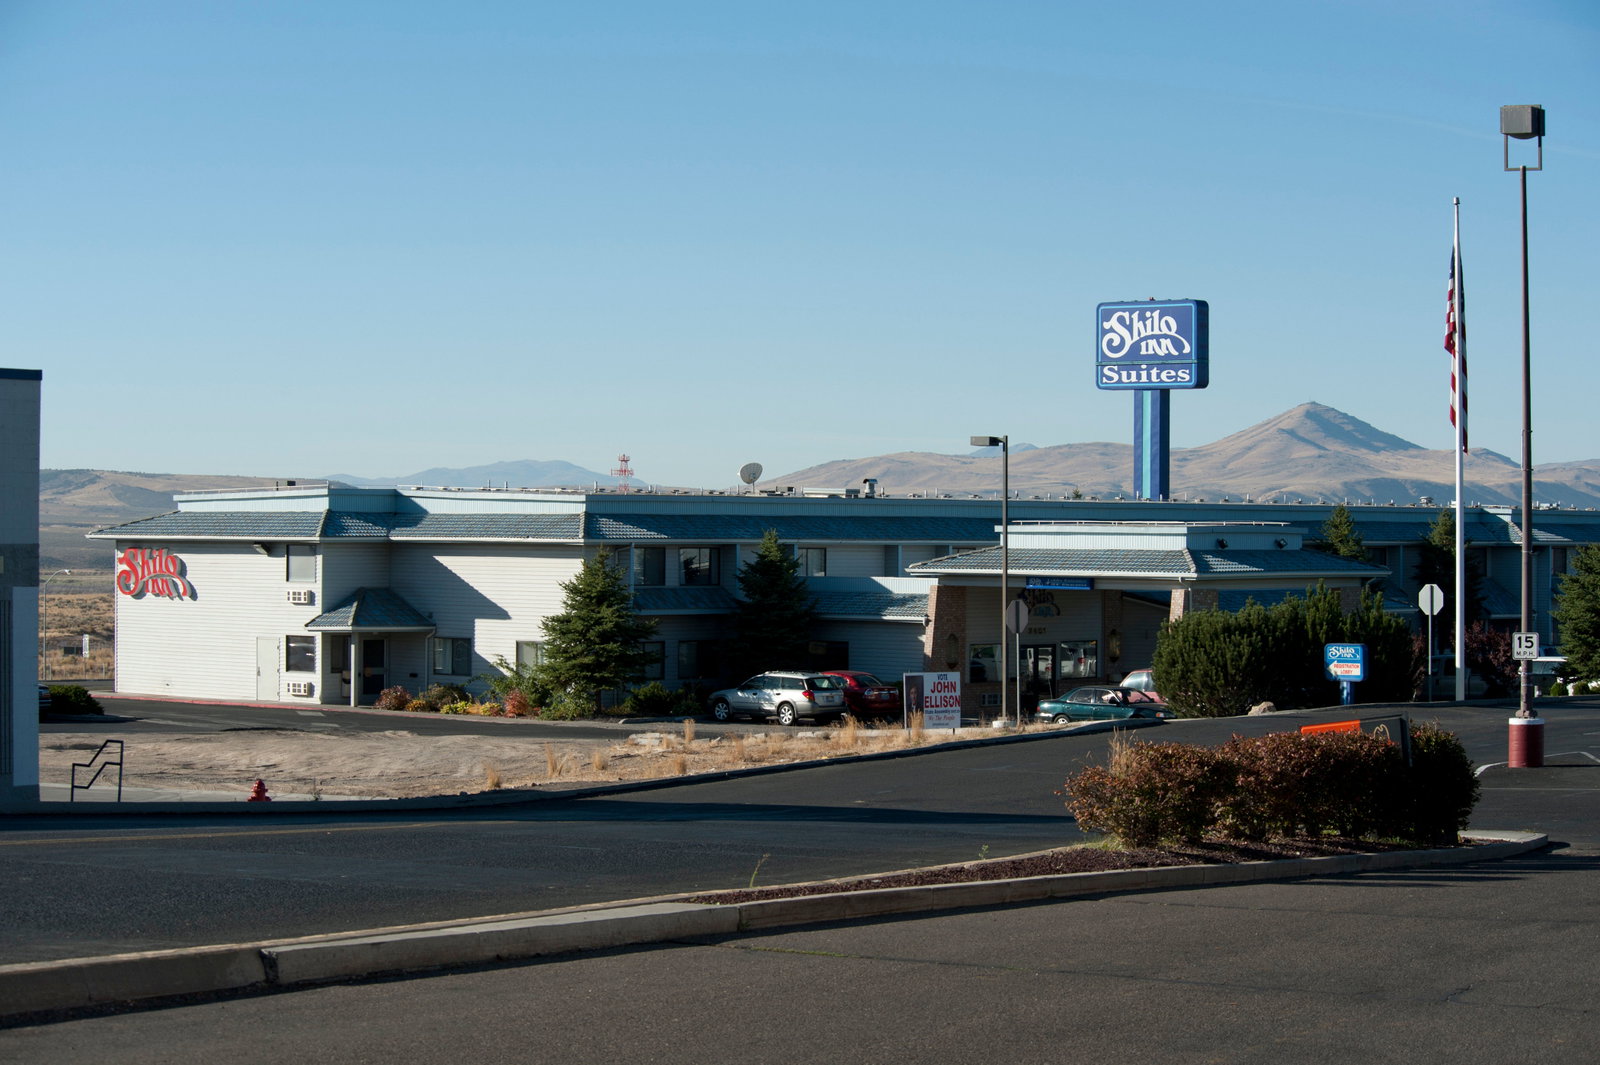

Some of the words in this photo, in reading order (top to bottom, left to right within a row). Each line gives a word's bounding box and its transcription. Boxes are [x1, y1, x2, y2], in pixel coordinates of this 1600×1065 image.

[1102, 309, 1191, 359] Shilo
[1102, 364, 1191, 384] Suites
[117, 548, 189, 596] Shilo
[1517, 635, 1534, 649] 15
[930, 681, 957, 693] JOHN
[924, 694, 960, 709] ELLISON
